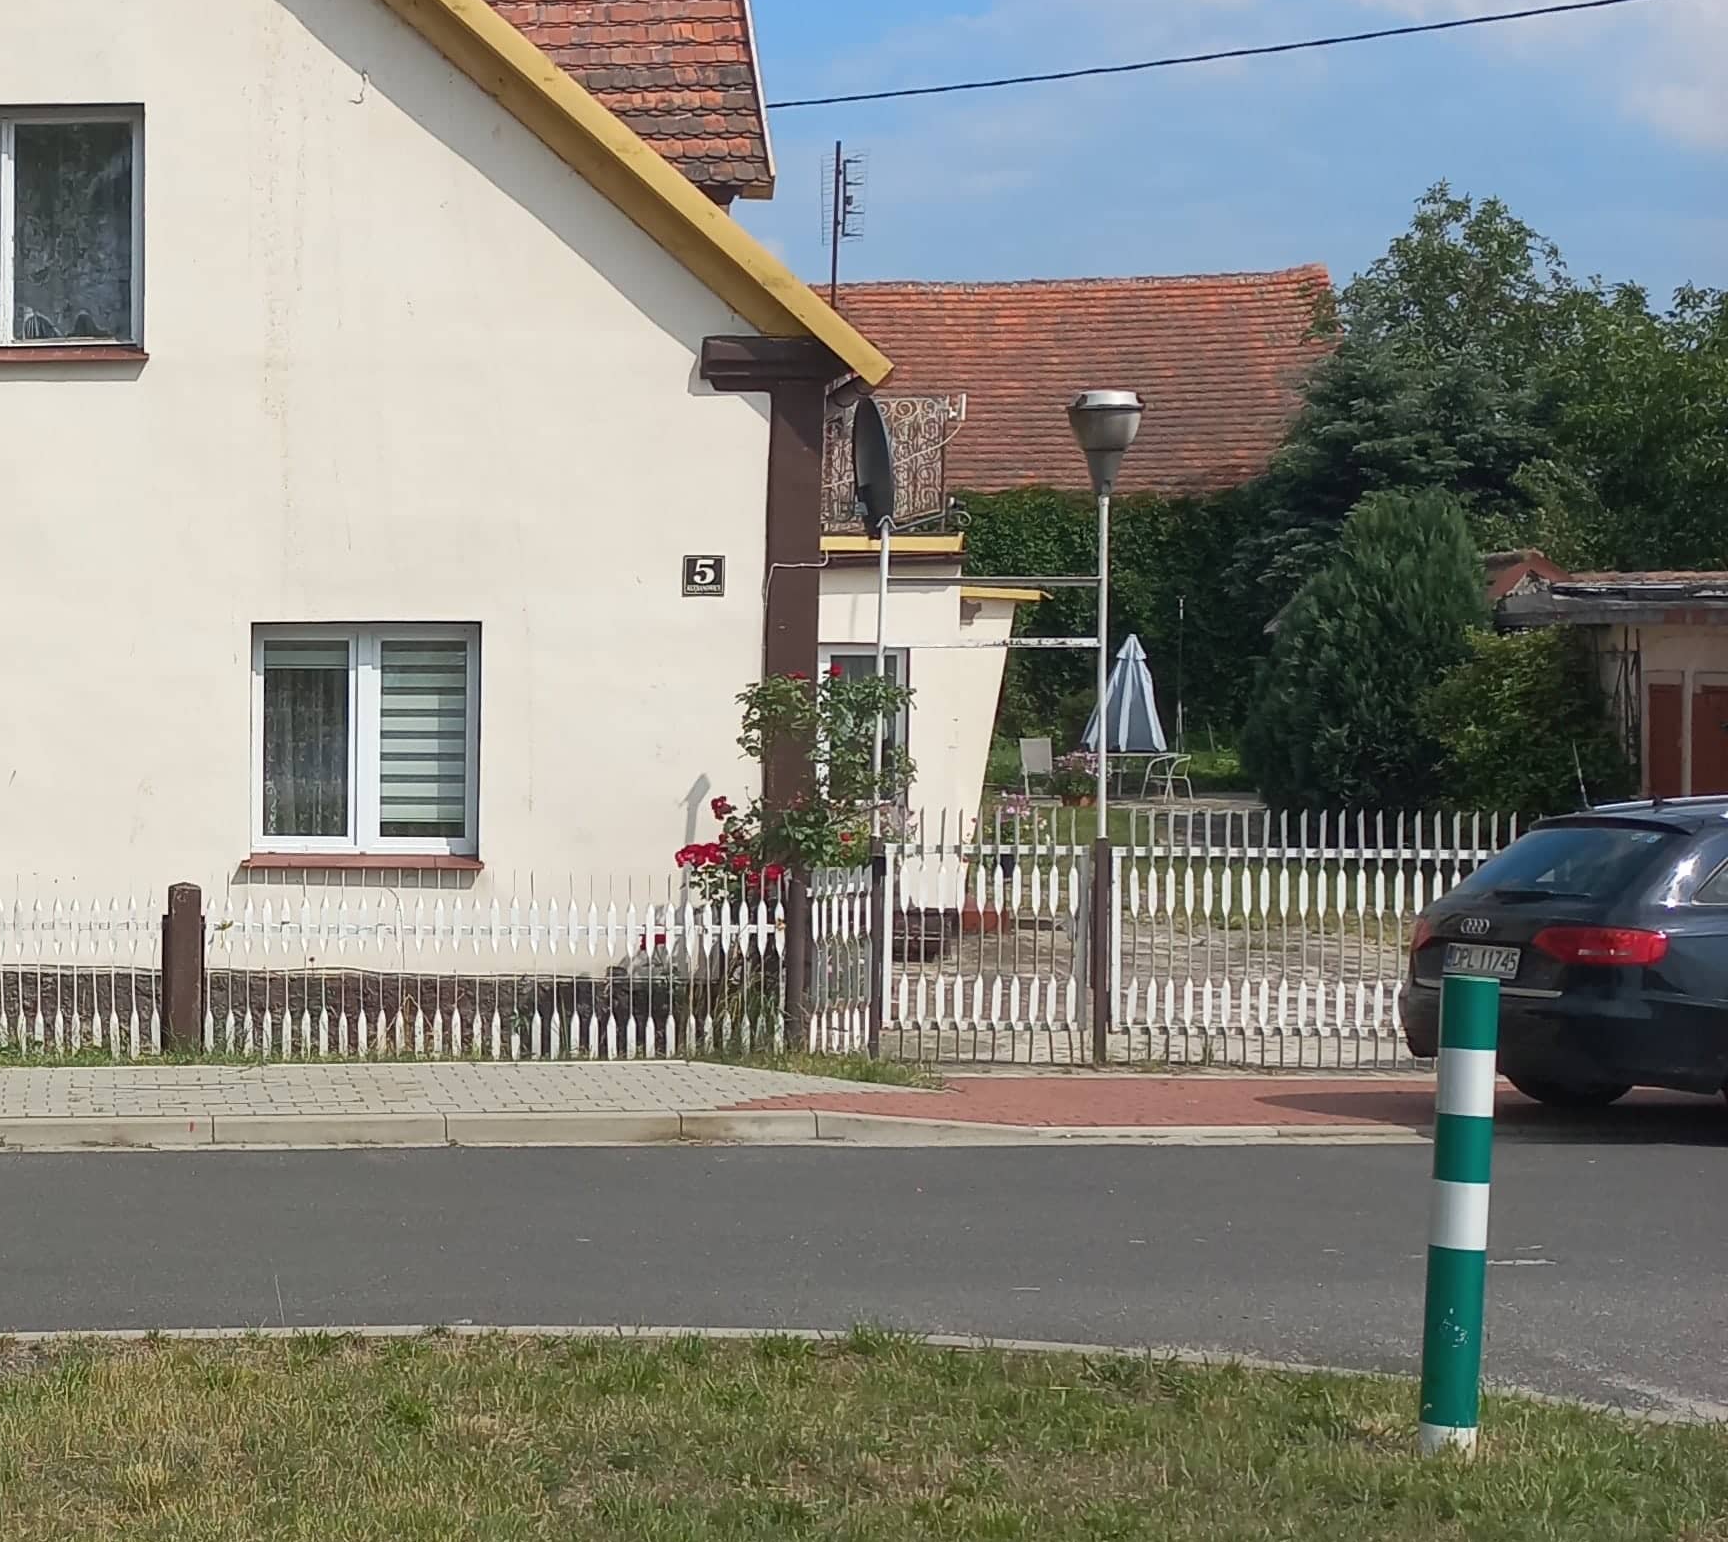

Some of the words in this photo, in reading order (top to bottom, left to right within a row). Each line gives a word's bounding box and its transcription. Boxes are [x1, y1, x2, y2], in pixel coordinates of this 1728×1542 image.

[693, 559, 715, 584] 5
[1452, 947, 1474, 968] DPL
[1480, 948, 1518, 972] 11745
